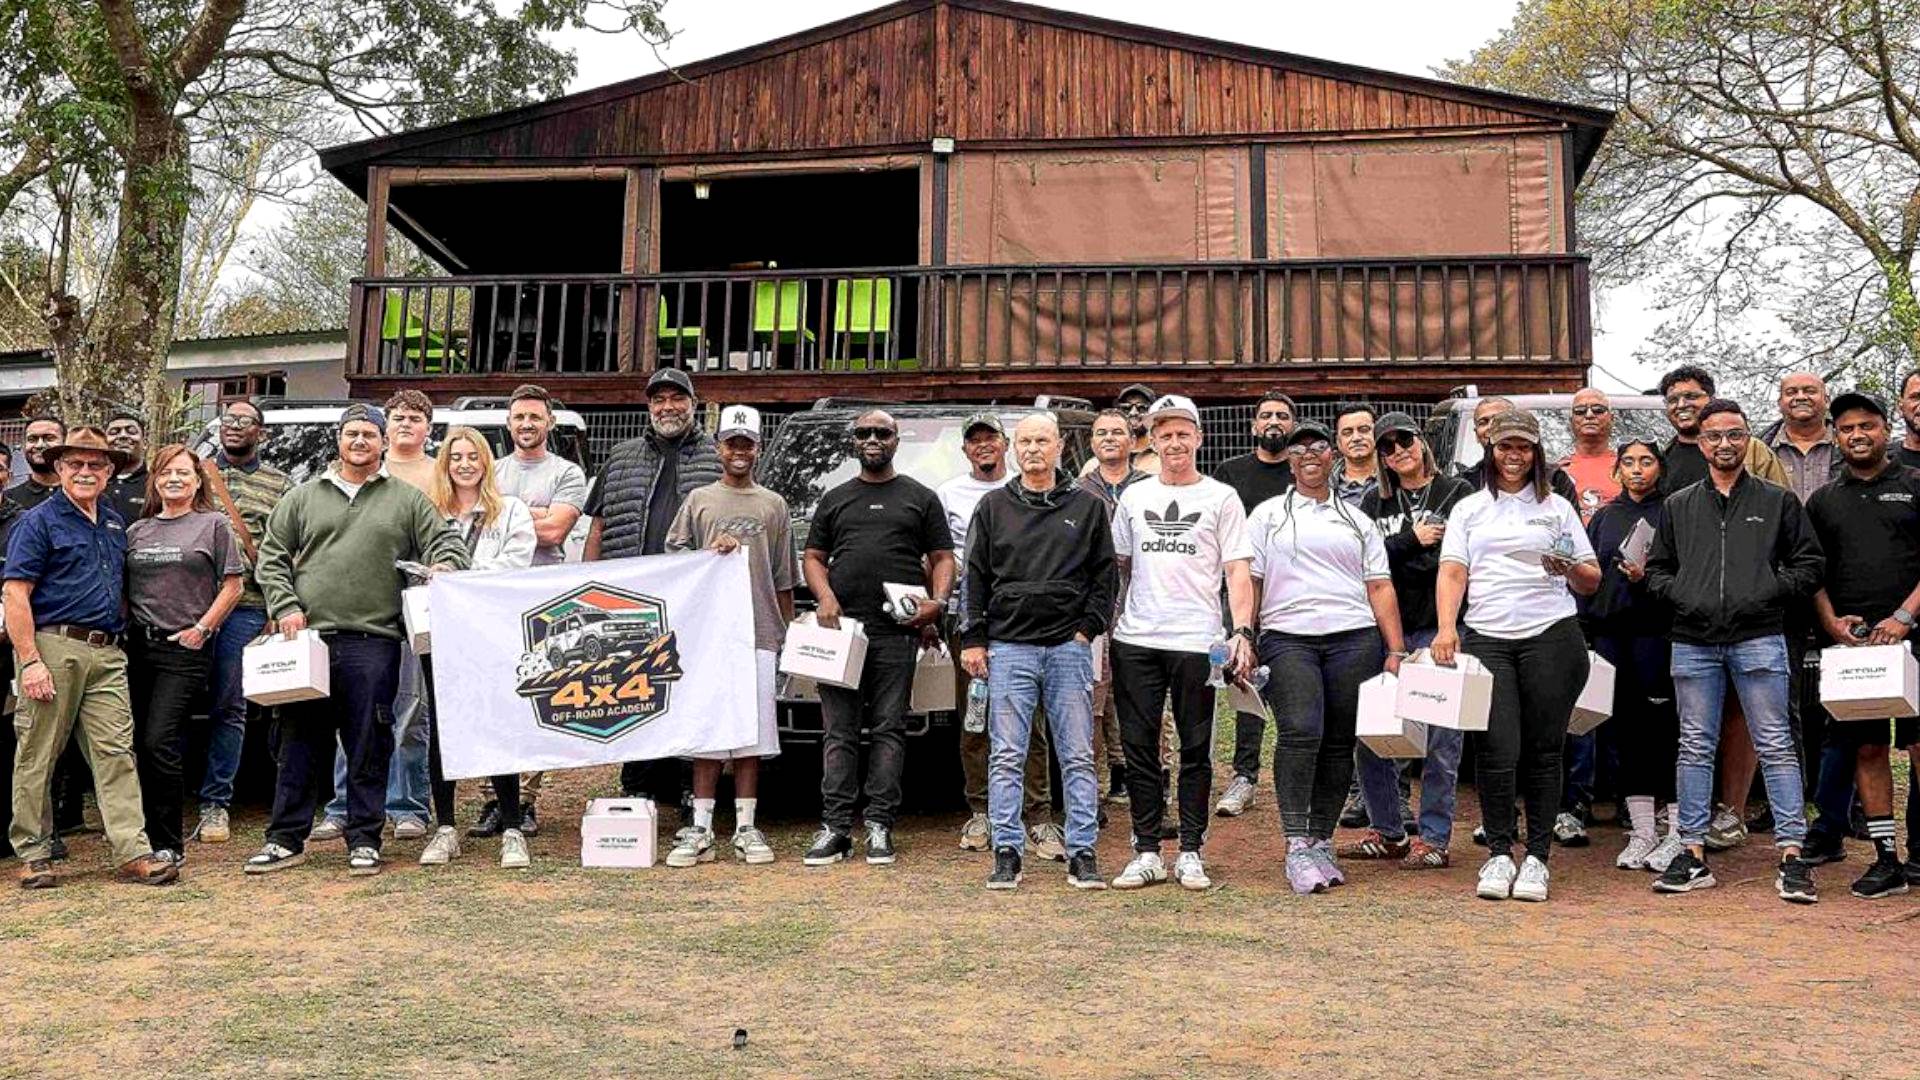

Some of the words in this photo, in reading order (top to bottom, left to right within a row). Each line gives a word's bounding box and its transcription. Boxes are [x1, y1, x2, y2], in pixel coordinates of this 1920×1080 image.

[1141, 538, 1197, 556] adidas
[591, 673, 613, 684] THE
[551, 708, 605, 723] OFF-ROAD
[606, 702, 657, 717] ACADEMY
